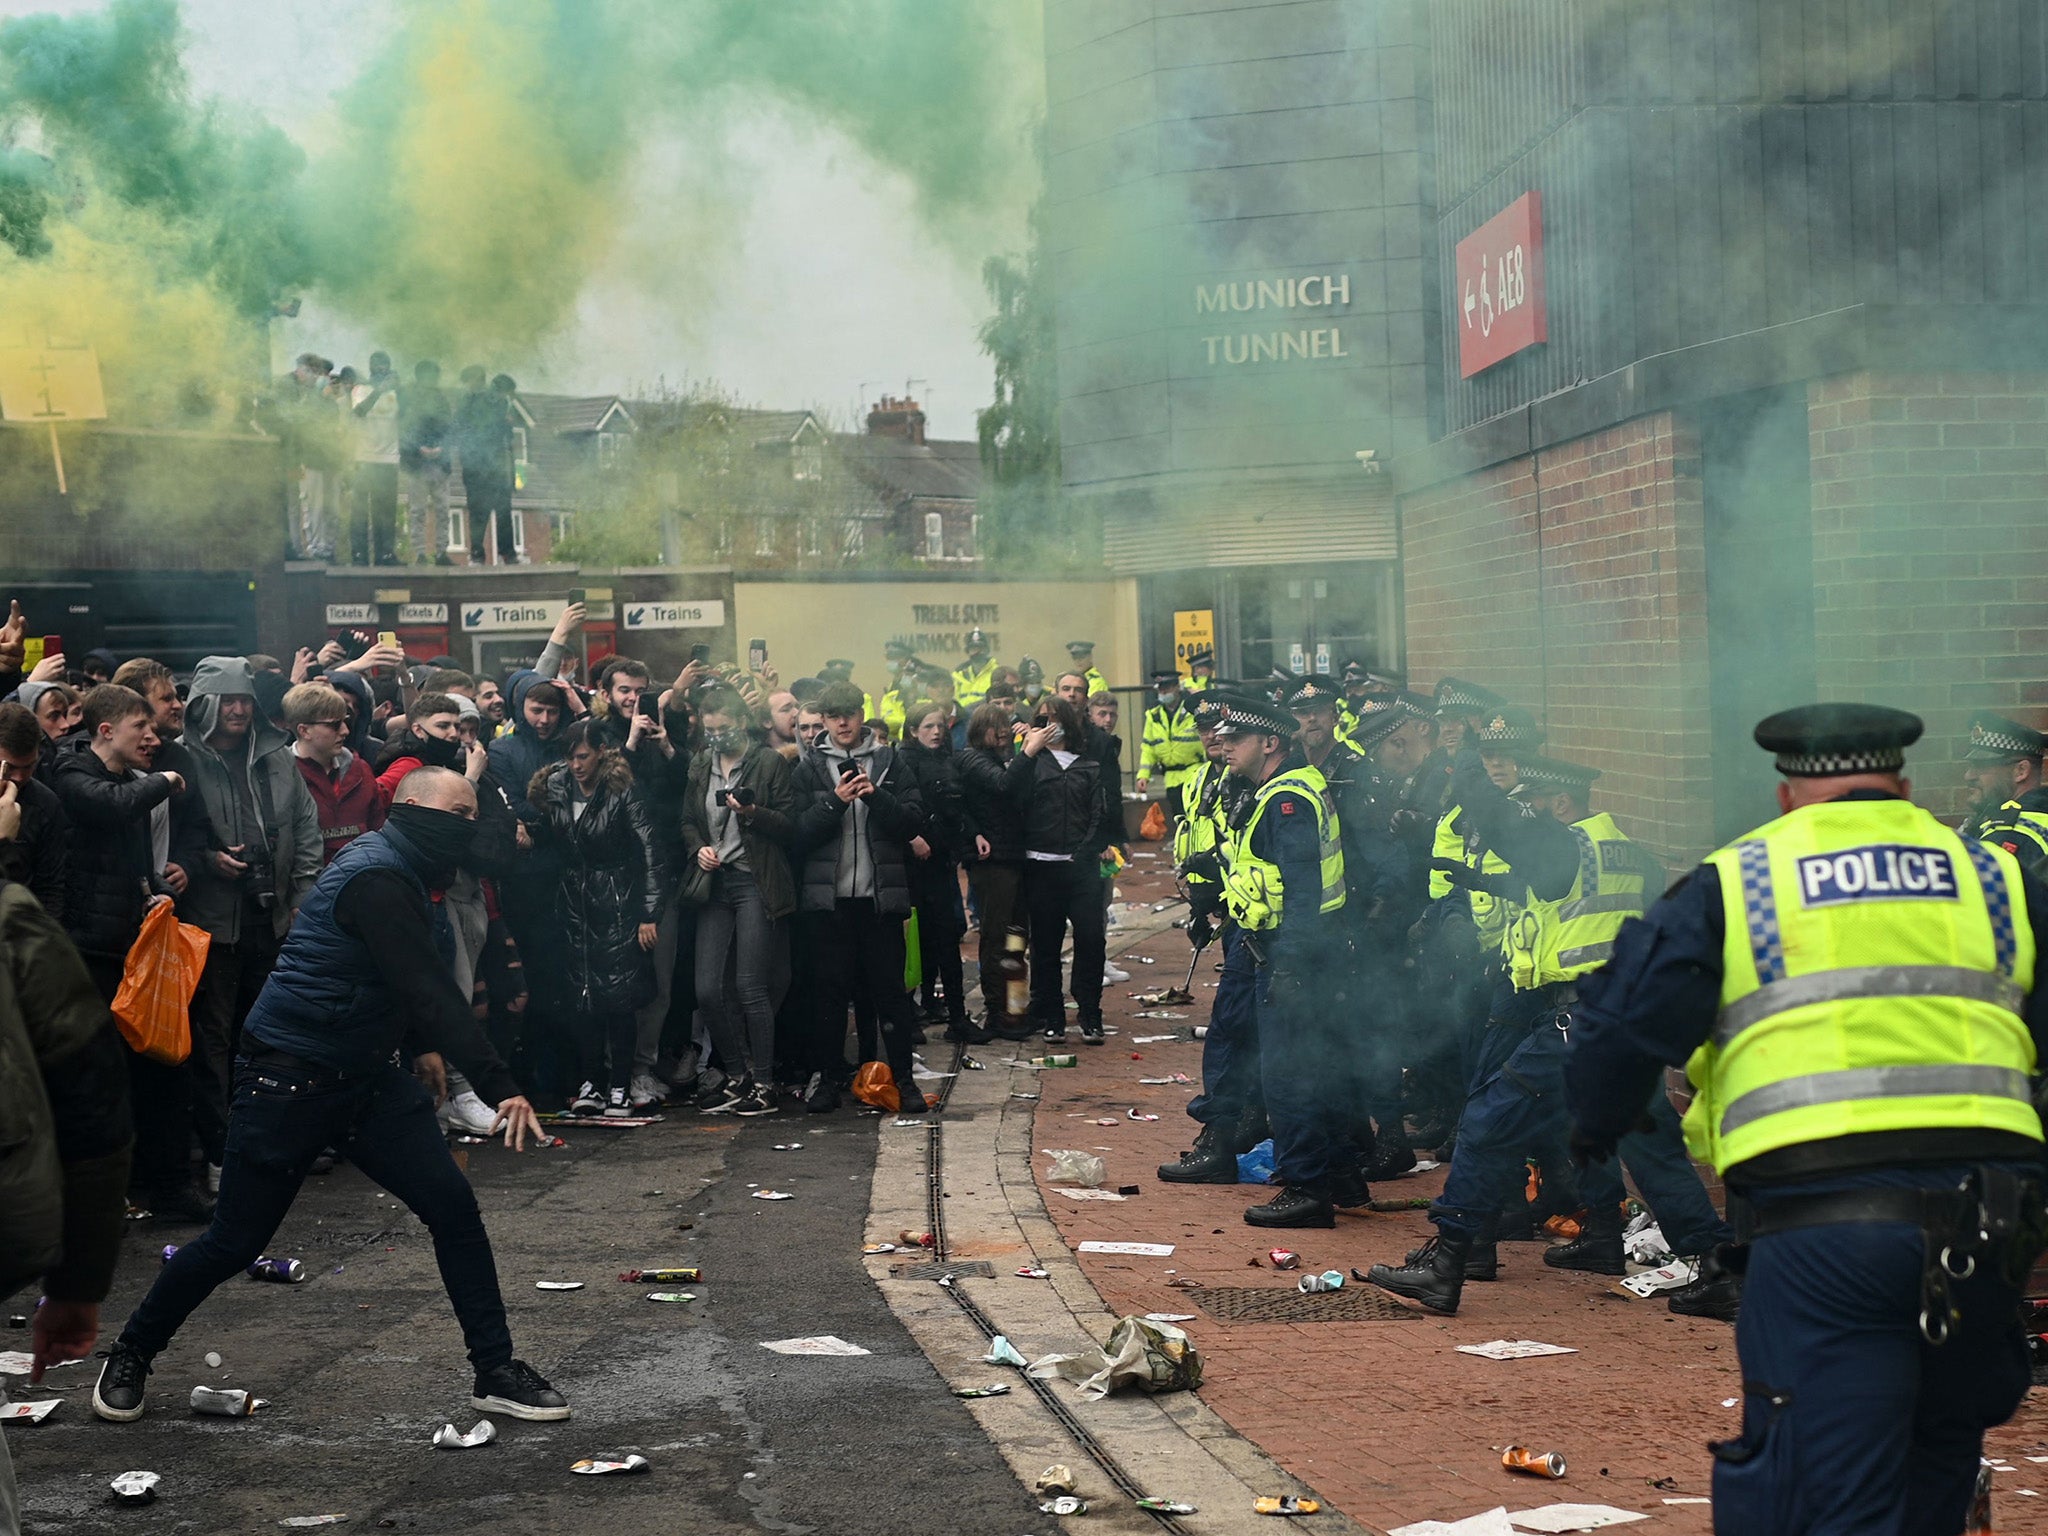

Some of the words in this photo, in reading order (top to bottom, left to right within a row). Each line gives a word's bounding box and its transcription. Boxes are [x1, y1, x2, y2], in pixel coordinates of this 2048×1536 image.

[1498, 244, 1525, 316] AE8
[1195, 274, 1350, 314] MUNICH
[1201, 327, 1348, 365] TUNNEL
[328, 606, 363, 618] Tickets
[400, 605, 433, 618] Tickets
[493, 606, 547, 622] Trains
[652, 605, 702, 621] Trains
[912, 603, 960, 625] TREBLE
[963, 603, 999, 625] SUITE
[1803, 851, 1954, 898] POLICE
